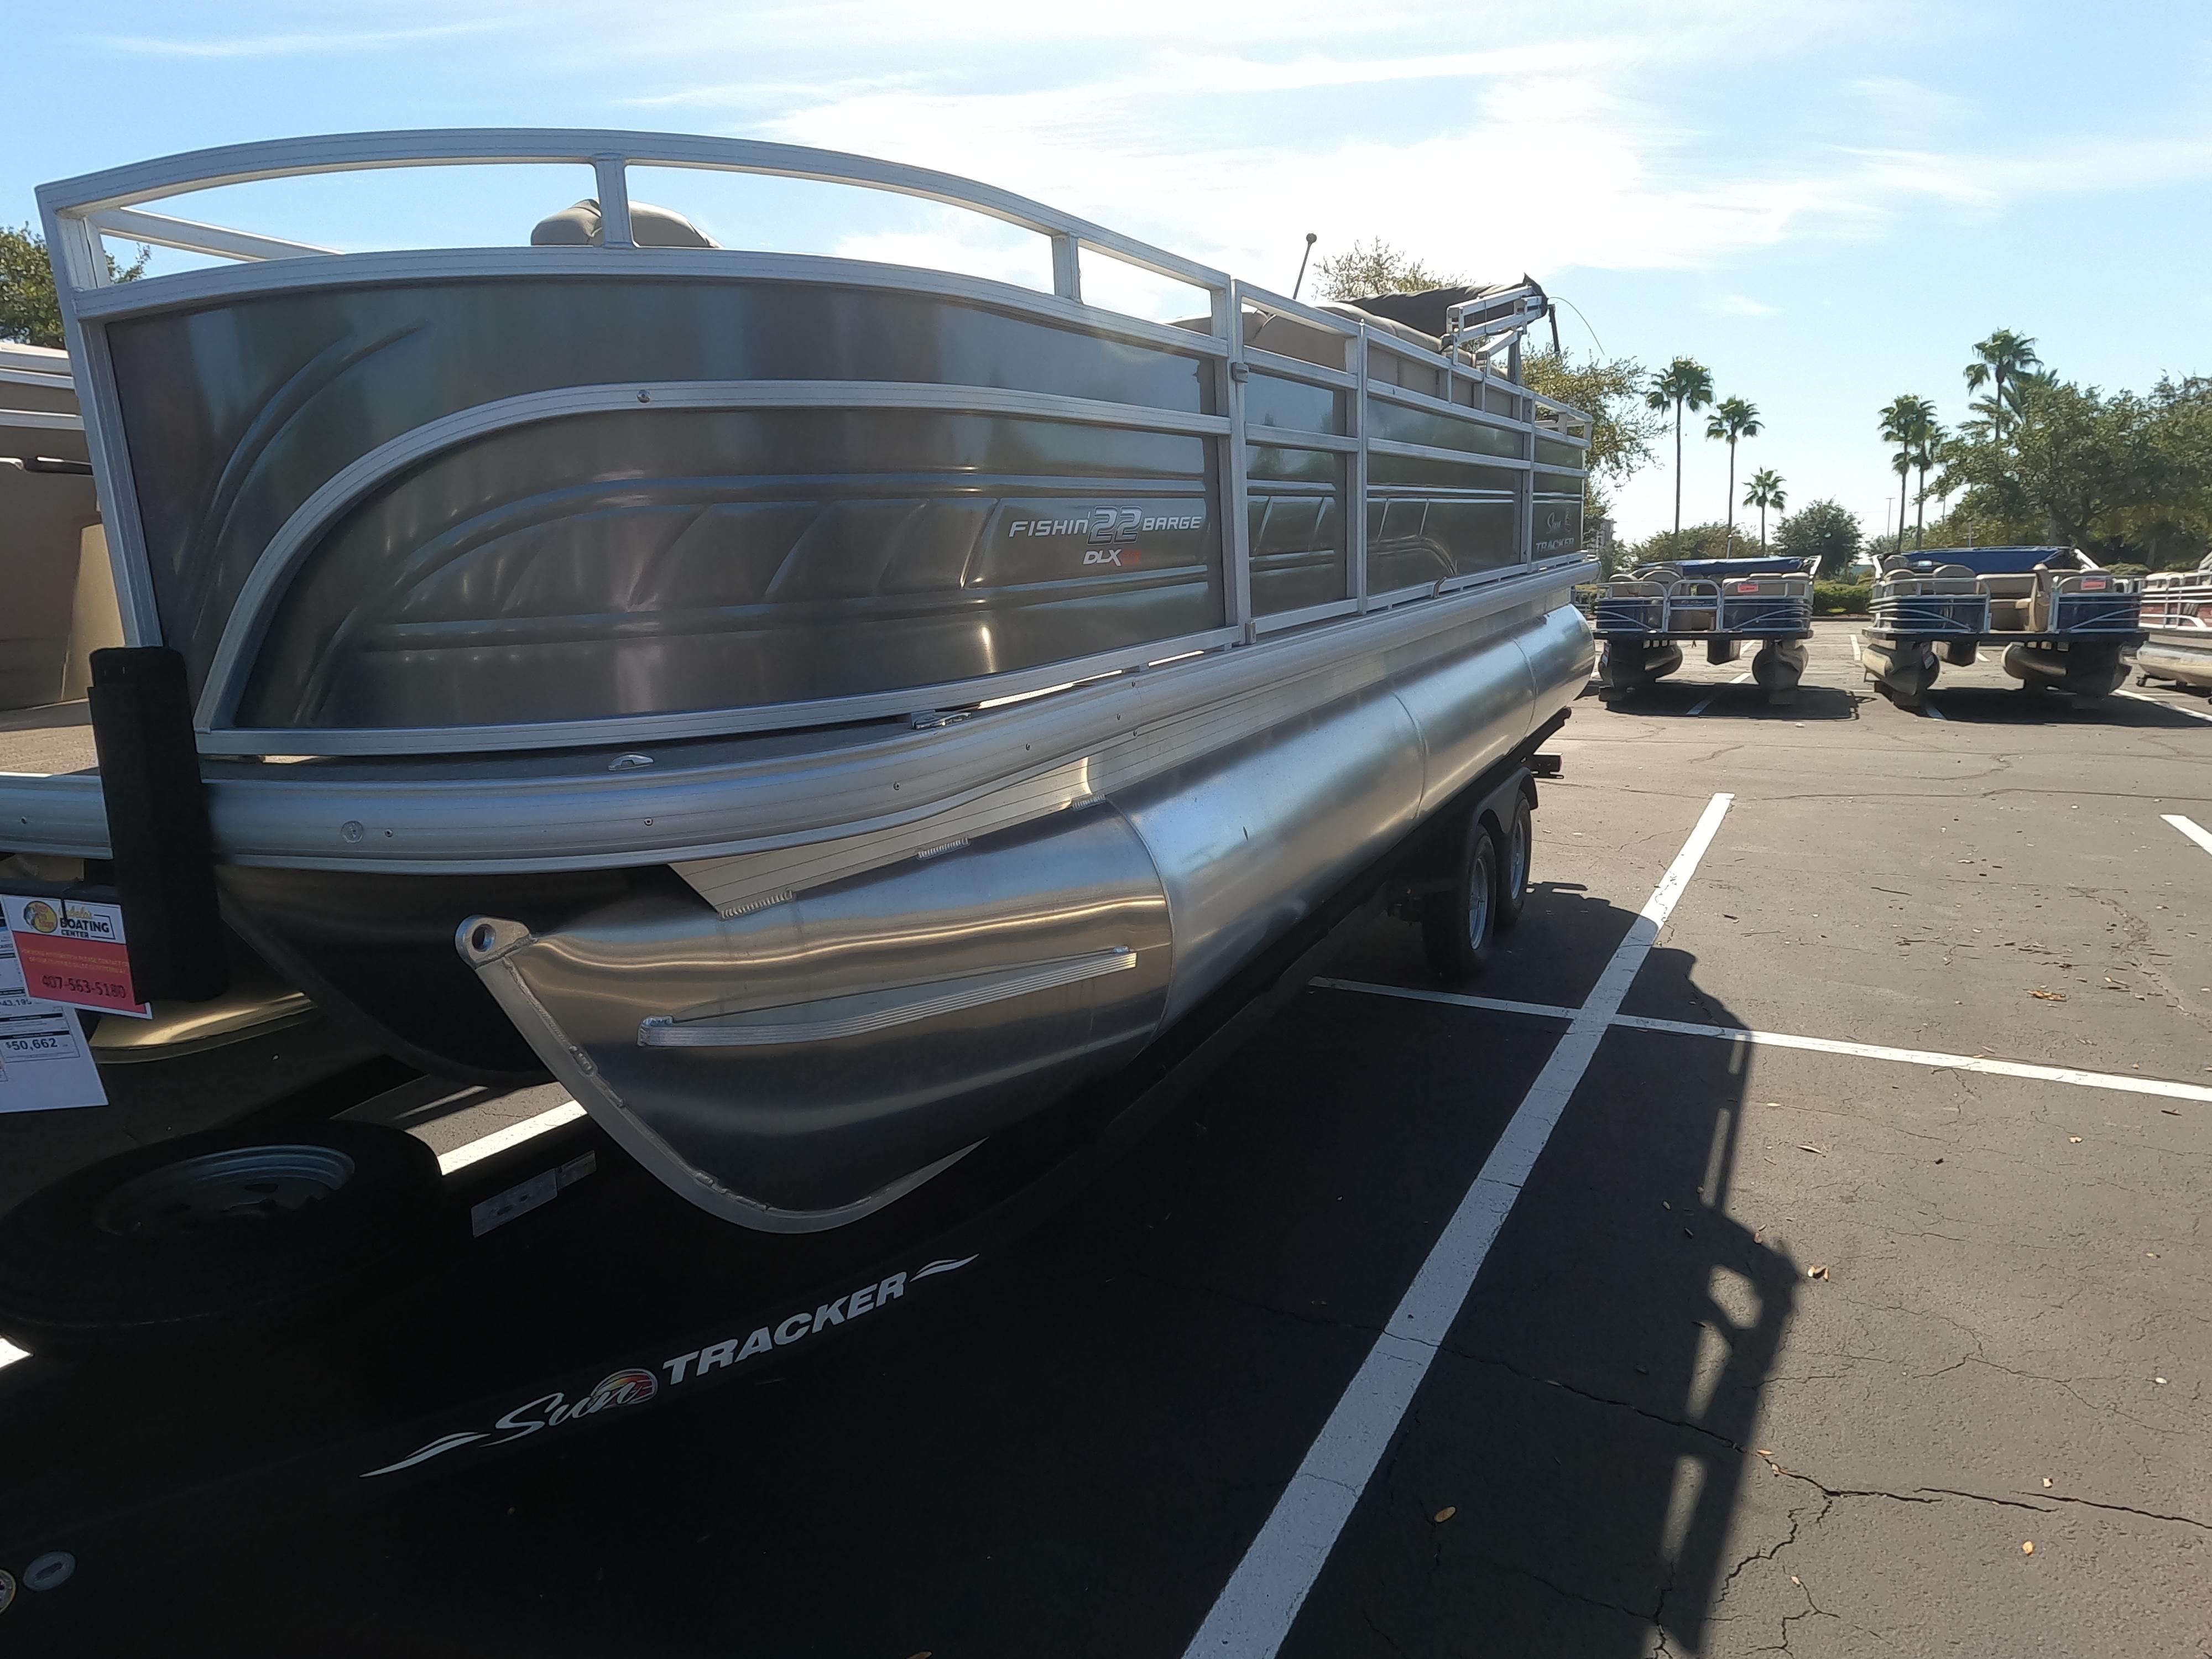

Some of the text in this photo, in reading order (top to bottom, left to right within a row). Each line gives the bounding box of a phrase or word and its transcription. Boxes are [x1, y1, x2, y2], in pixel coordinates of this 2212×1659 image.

[1087, 505, 1142, 545] 22
[1142, 516, 1202, 531] BARGE
[1536, 538, 1574, 553] TRACKER
[1083, 549, 1121, 566] DLX
[60, 918, 109, 933] BOATING
[61, 930, 89, 939] CENTER
[6, 1038, 58, 1051] $50,662
[479, 1271, 909, 1448] Sun TRACKER
